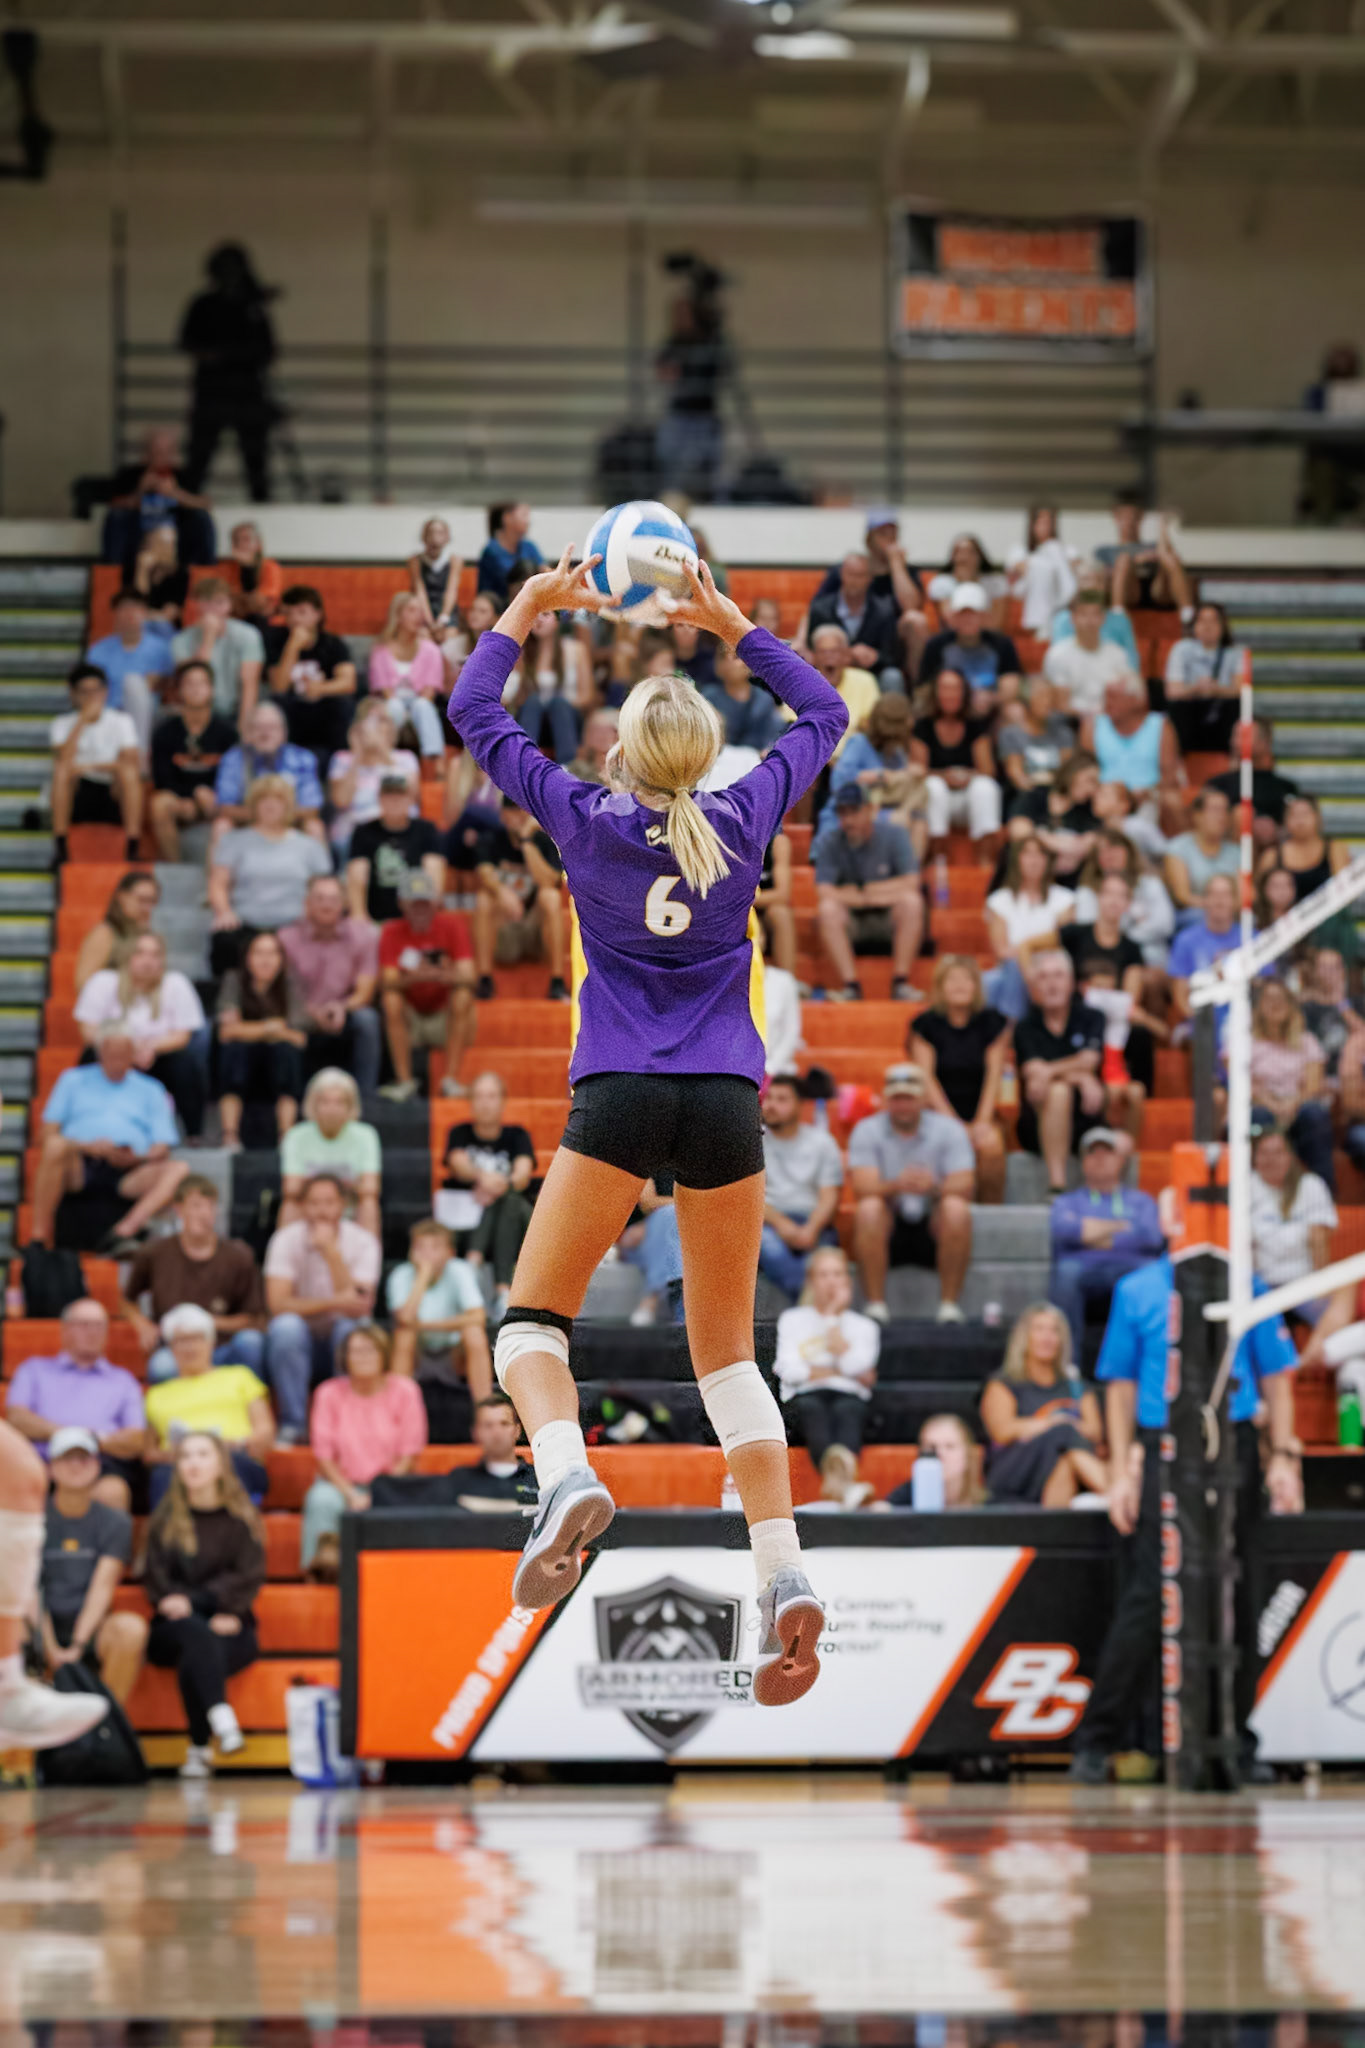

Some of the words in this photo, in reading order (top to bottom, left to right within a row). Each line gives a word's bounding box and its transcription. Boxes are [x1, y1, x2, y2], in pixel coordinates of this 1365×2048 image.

[645, 875, 692, 937] 6
[432, 1671, 492, 1750] PROUD
[477, 1605, 541, 1678] SPONS
[586, 1669, 753, 1688] ARMORED
[973, 1643, 1094, 1741] BC
